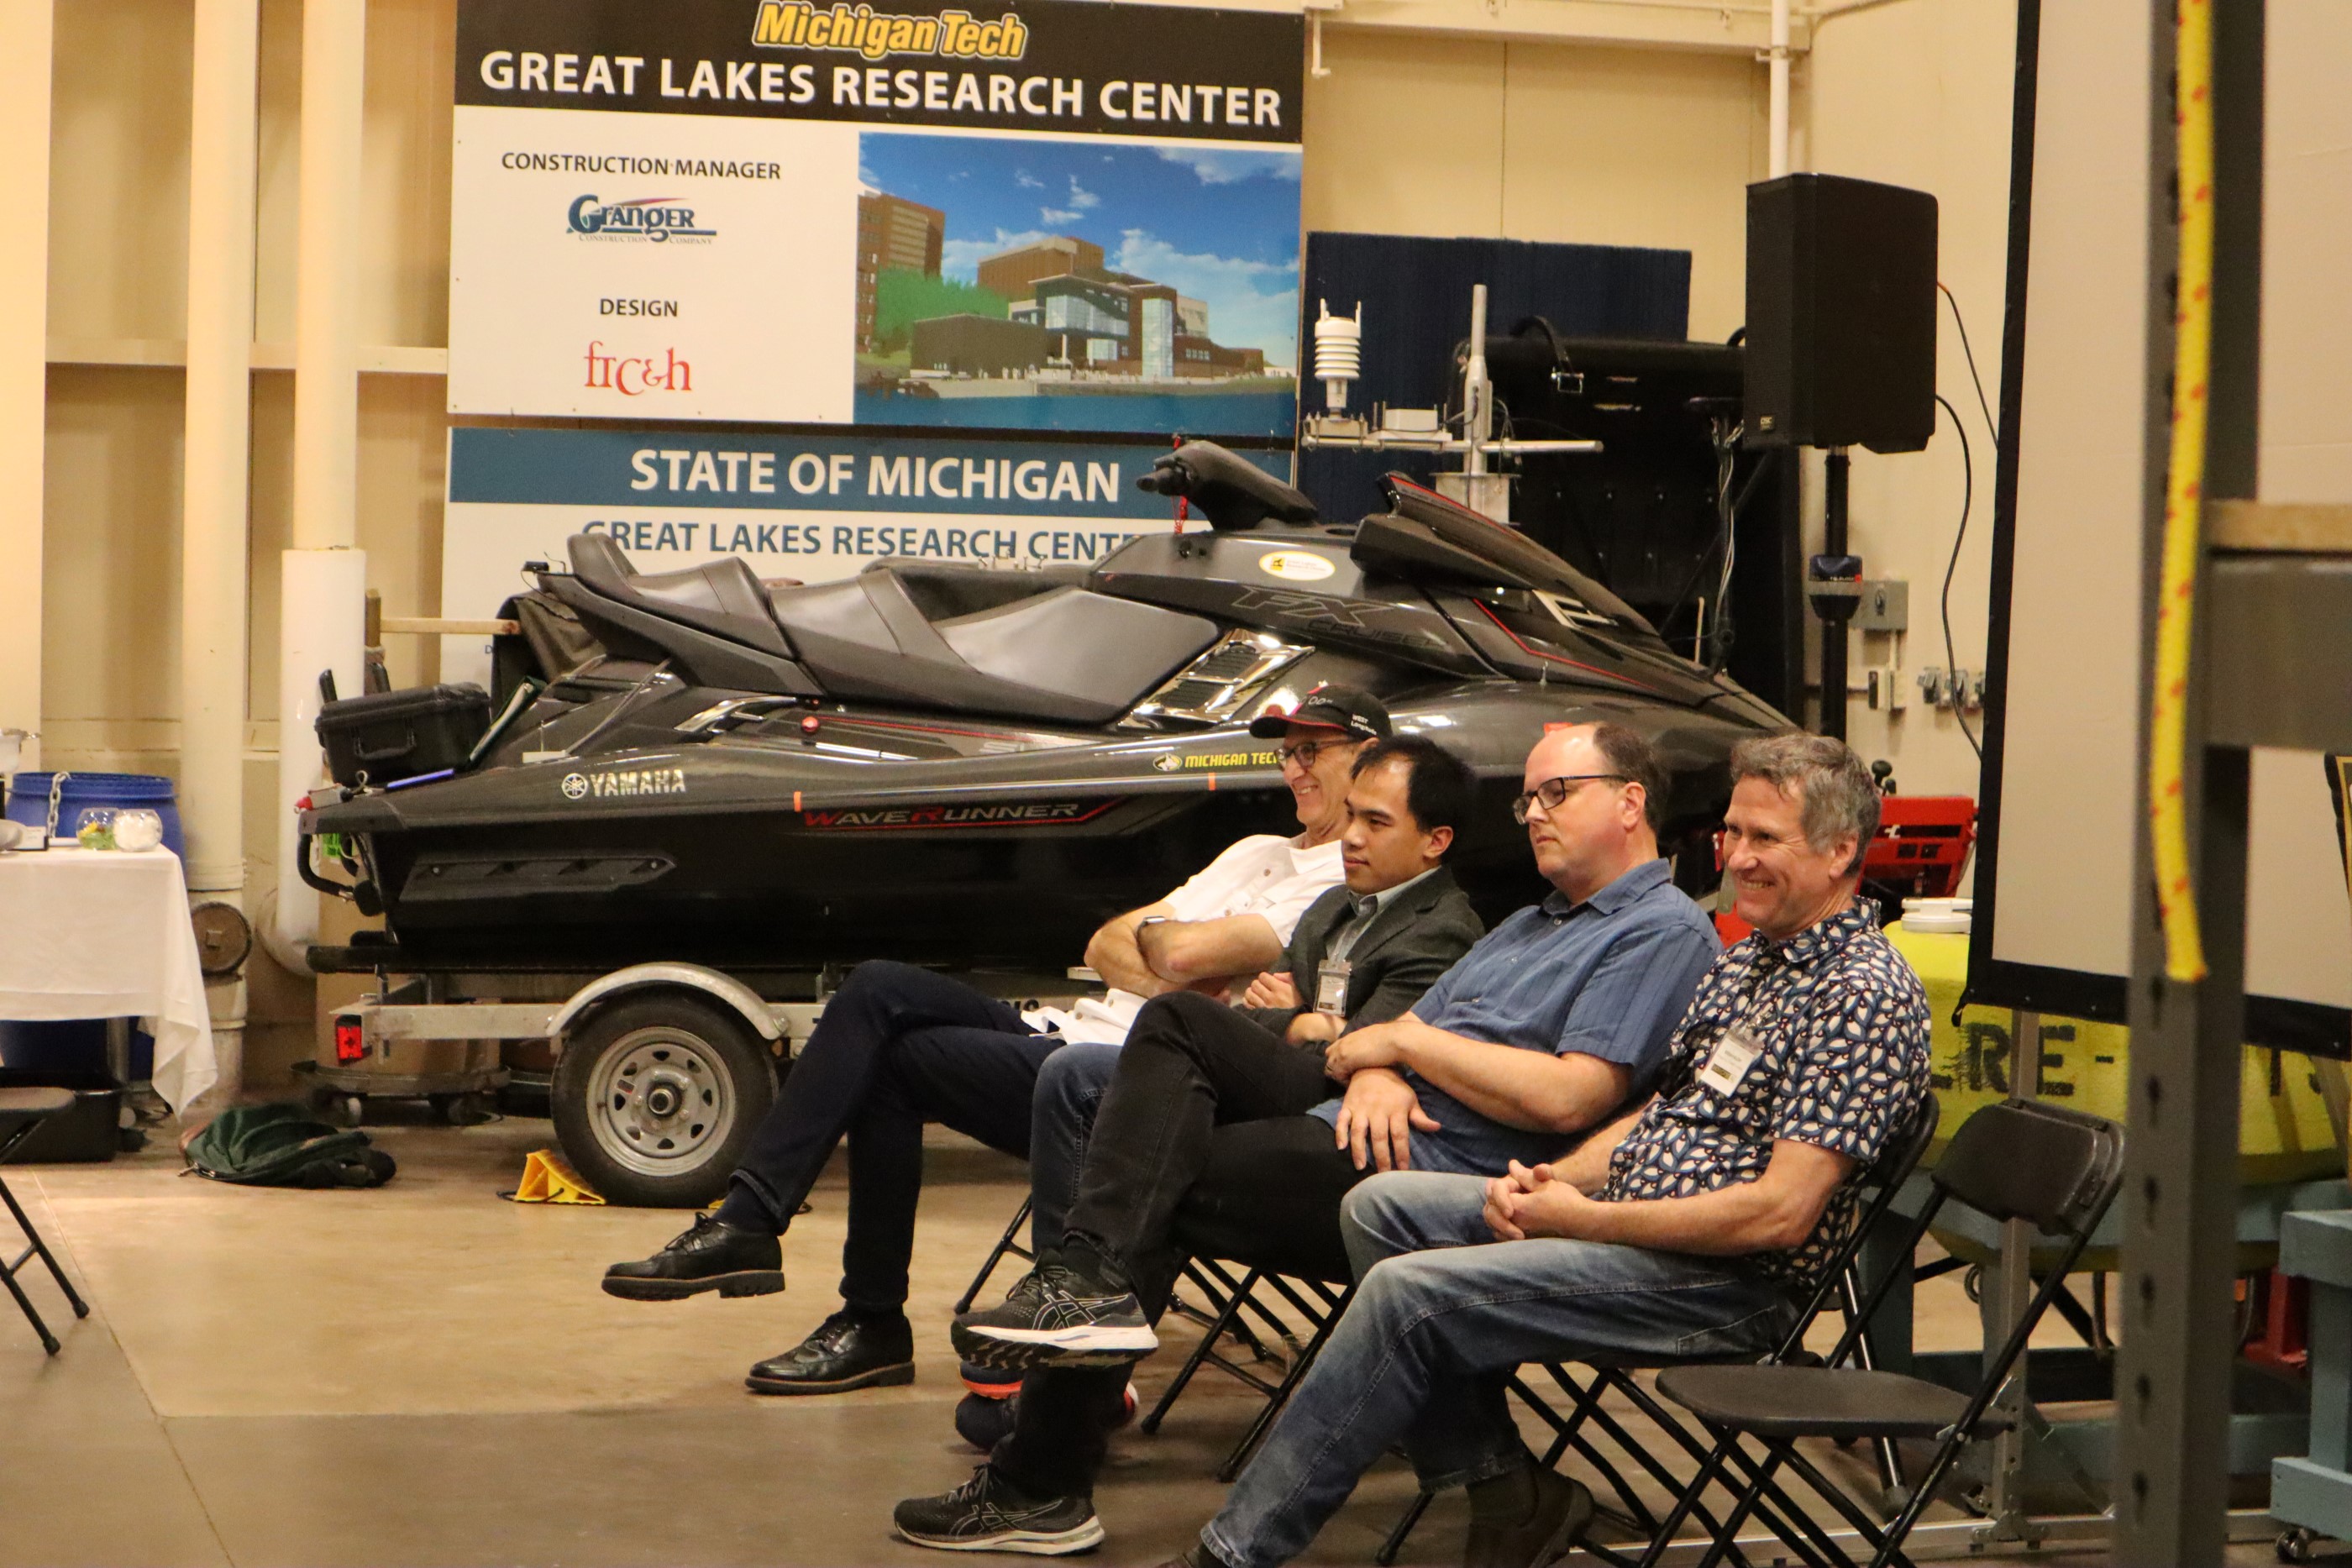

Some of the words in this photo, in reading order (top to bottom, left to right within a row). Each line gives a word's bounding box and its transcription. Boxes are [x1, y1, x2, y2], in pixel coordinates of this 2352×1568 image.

[754, 2, 939, 60] Michigan
[940, 11, 1026, 58] Tech
[480, 50, 644, 95] GREAT
[660, 58, 815, 103] LAKES
[832, 66, 1083, 117] RESEARCH
[1100, 81, 1281, 126] CENTER
[501, 152, 669, 175] CONSTRUCTION
[675, 160, 781, 180] MANAGER
[600, 298, 678, 317] DESIGN
[630, 448, 775, 493] STATE
[788, 454, 854, 495] OF
[867, 456, 1120, 502] MICHIGAN
[710, 523, 821, 554] LAKES
[832, 527, 1017, 559] RESEARCH
[1027, 531, 1136, 560] CENT
[1231, 585, 1394, 627] FX
[1184, 753, 1247, 768] MICHIGAN
[590, 769, 686, 797] YAMAHA
[804, 803, 1079, 826] WAVERUNNER
